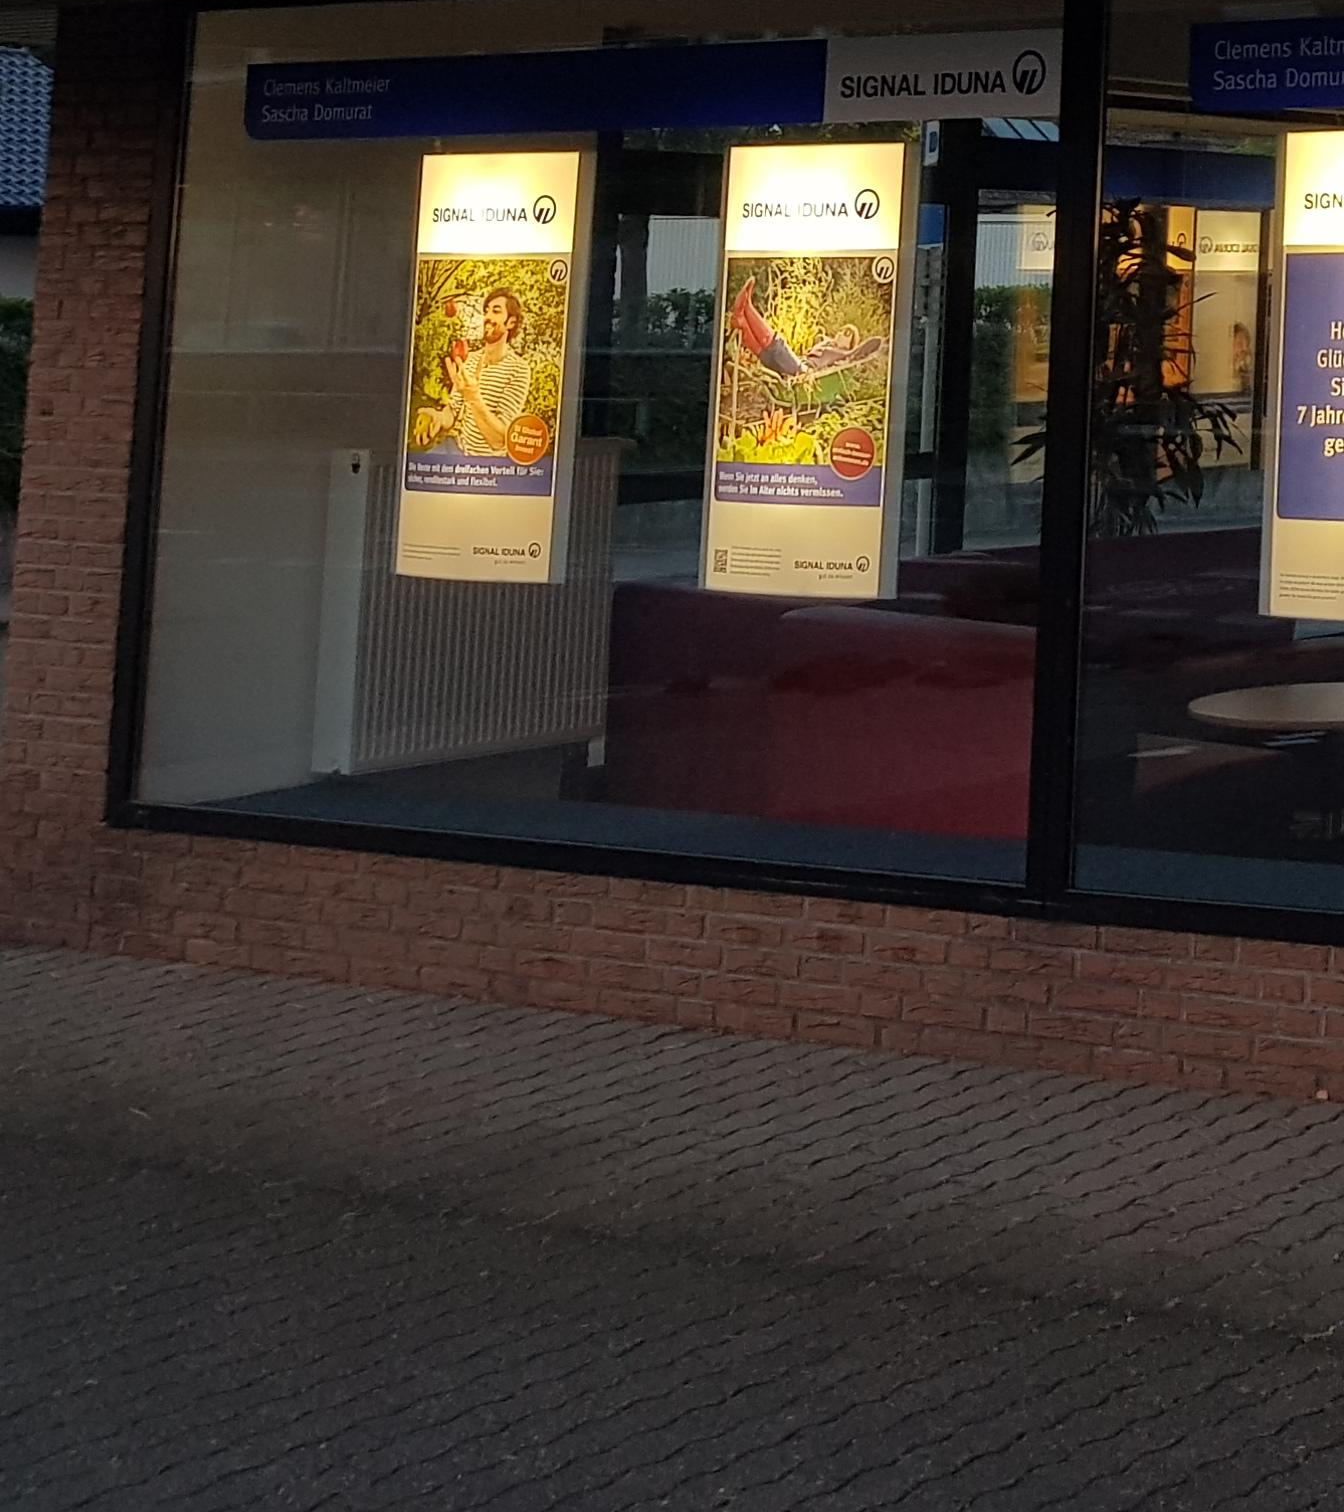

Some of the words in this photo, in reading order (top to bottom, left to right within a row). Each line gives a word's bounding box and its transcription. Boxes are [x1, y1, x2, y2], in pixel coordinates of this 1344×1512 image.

[1214, 40, 1292, 60] Clemens
[264, 78, 320, 96] Clemens
[325, 76, 391, 94] Kaltmeier
[840, 73, 926, 99] SIGNAL
[933, 70, 1007, 95] IDUNA
[1213, 69, 1277, 90] Sascha
[261, 104, 308, 122] Sascha
[314, 104, 373, 121] Domurat
[432, 207, 475, 222] SIGNAL
[742, 202, 791, 219] SIGNAL
[1297, 406, 1307, 424] 7
[455, 464, 490, 474] dreifachen
[490, 465, 516, 475] Vorteil
[745, 472, 760, 484] jetzt
[770, 473, 787, 484] alles
[788, 474, 818, 486] denken,
[759, 485, 776, 496] Alter
[776, 486, 799, 497] nichts
[801, 486, 844, 498] vermissen.
[472, 546, 499, 557] SIGNAL
[794, 560, 824, 570] SIGNAL
[825, 561, 854, 571] IDUNA
